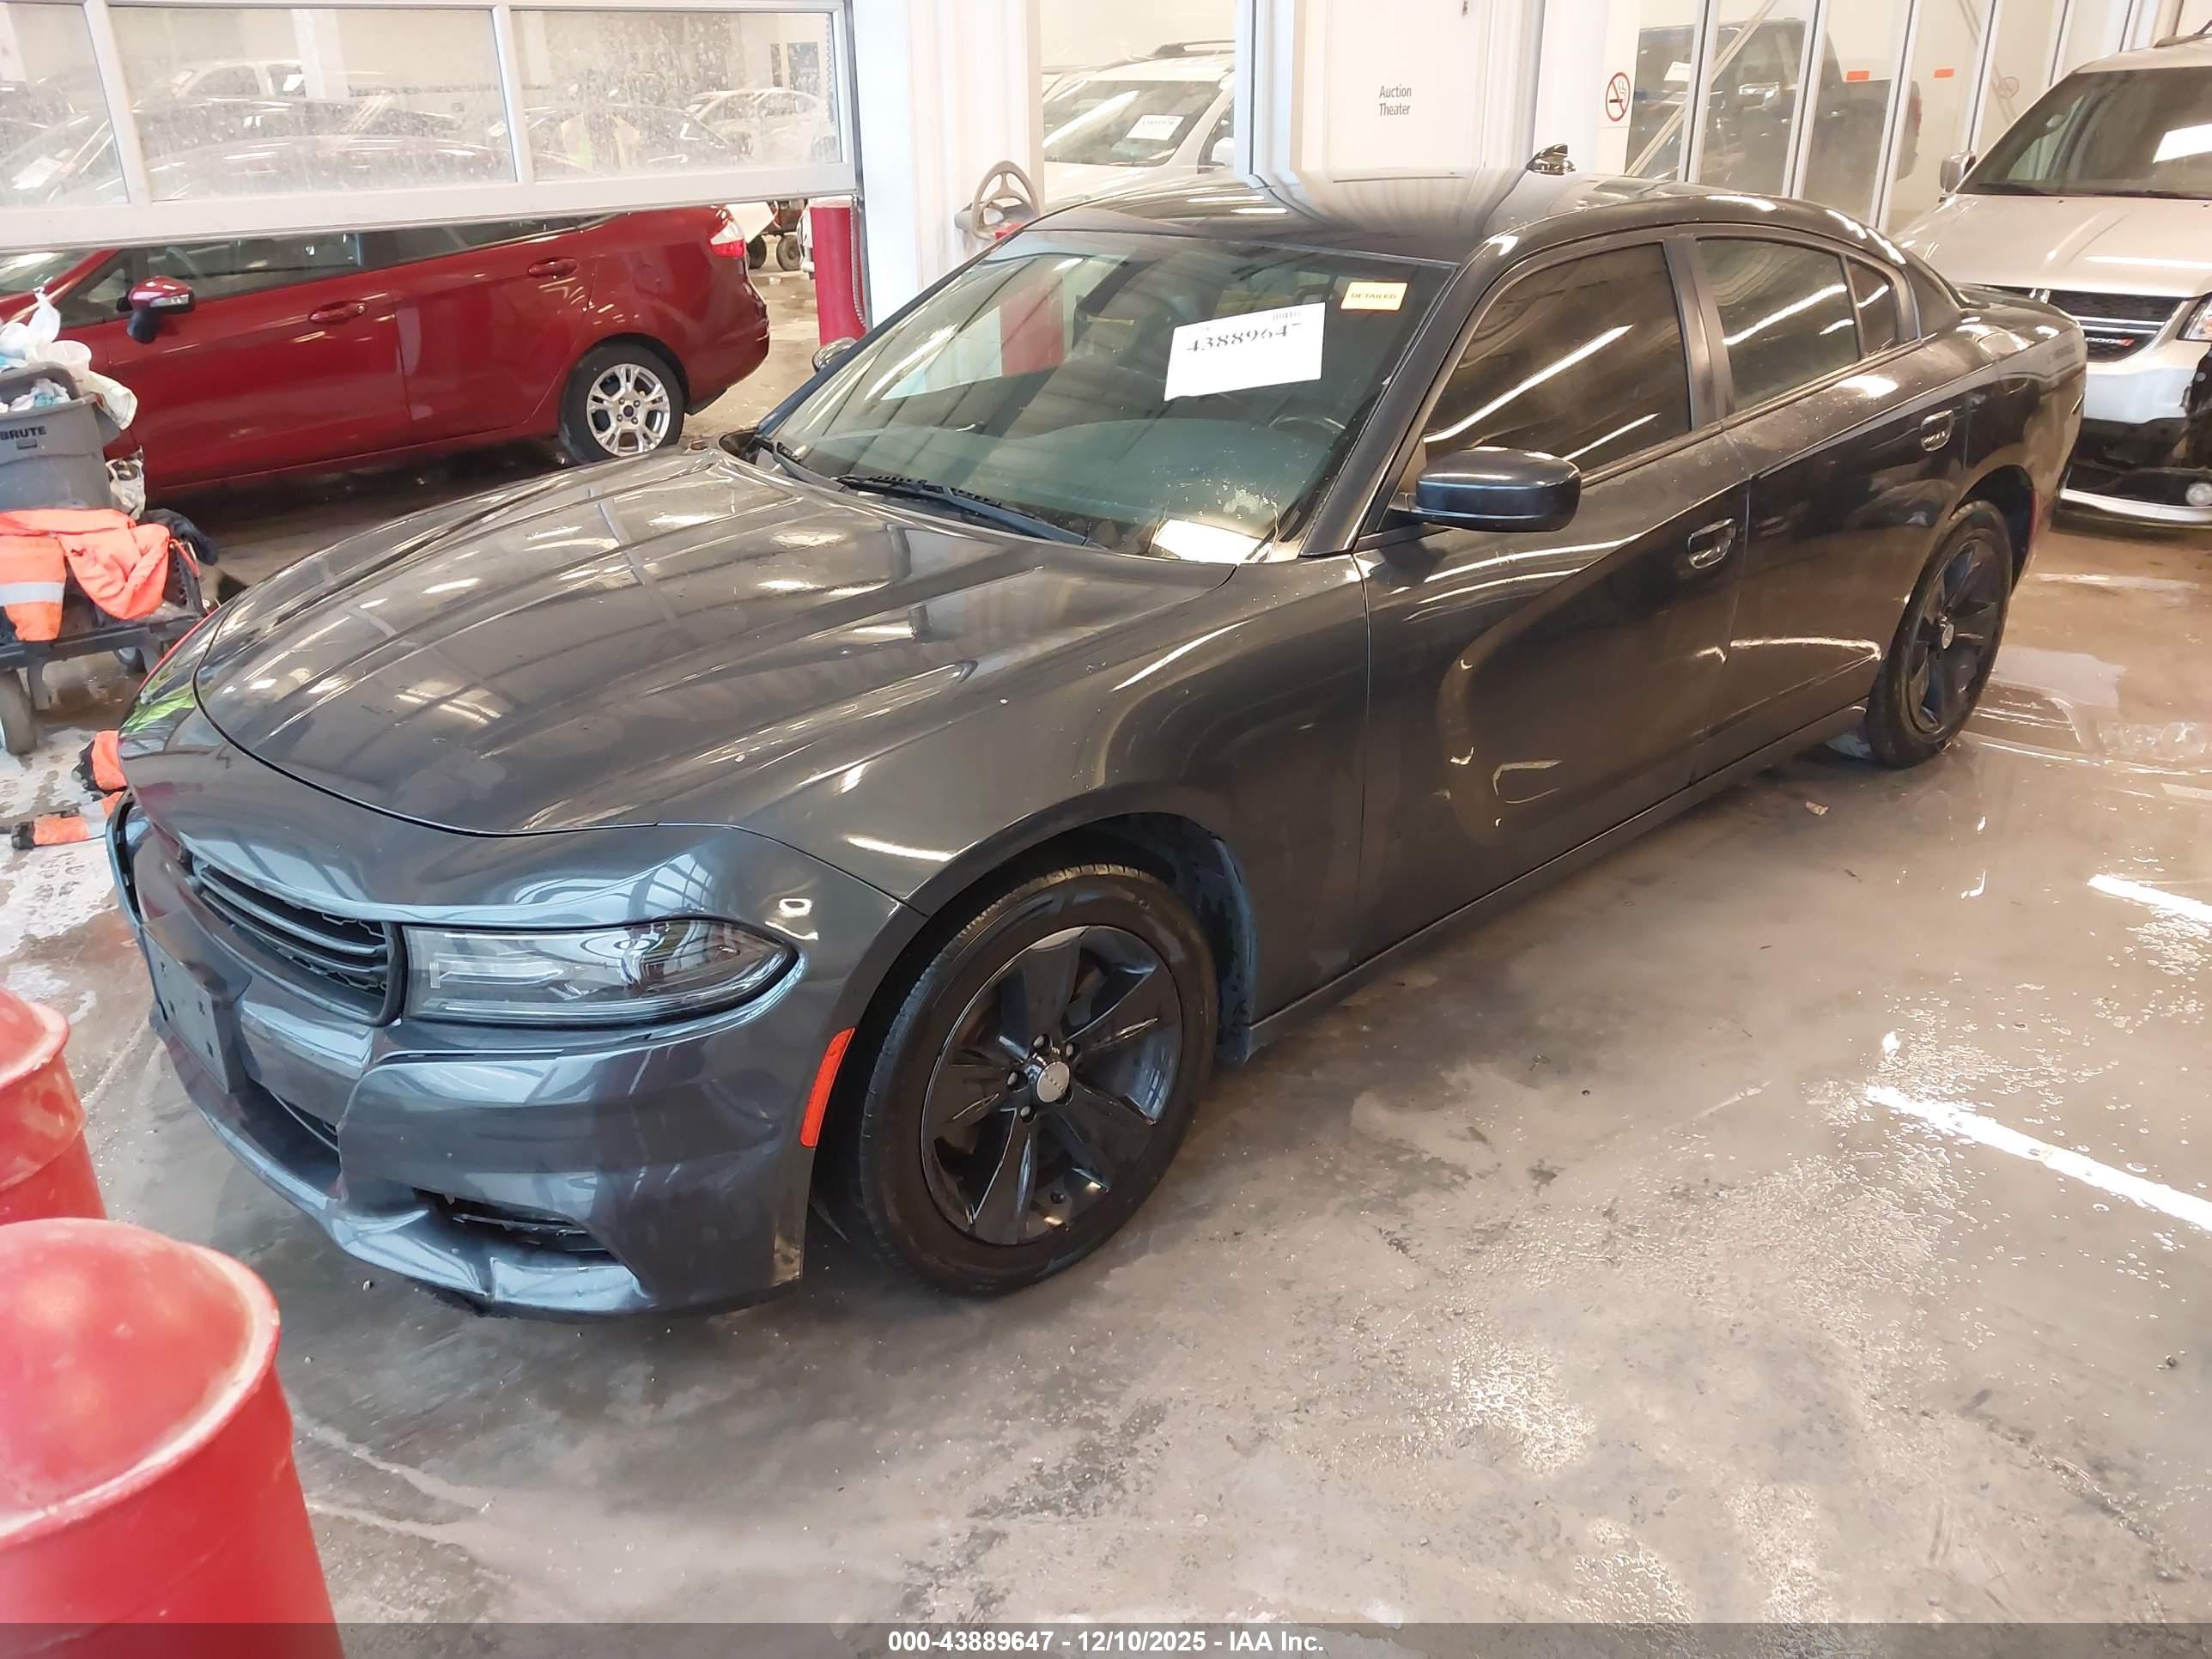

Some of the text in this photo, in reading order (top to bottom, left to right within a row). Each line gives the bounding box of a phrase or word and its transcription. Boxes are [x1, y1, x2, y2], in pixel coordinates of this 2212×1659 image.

[1379, 83, 1412, 98] Auction
[1379, 102, 1411, 116] Theater
[0, 426, 47, 441] BRUTE
